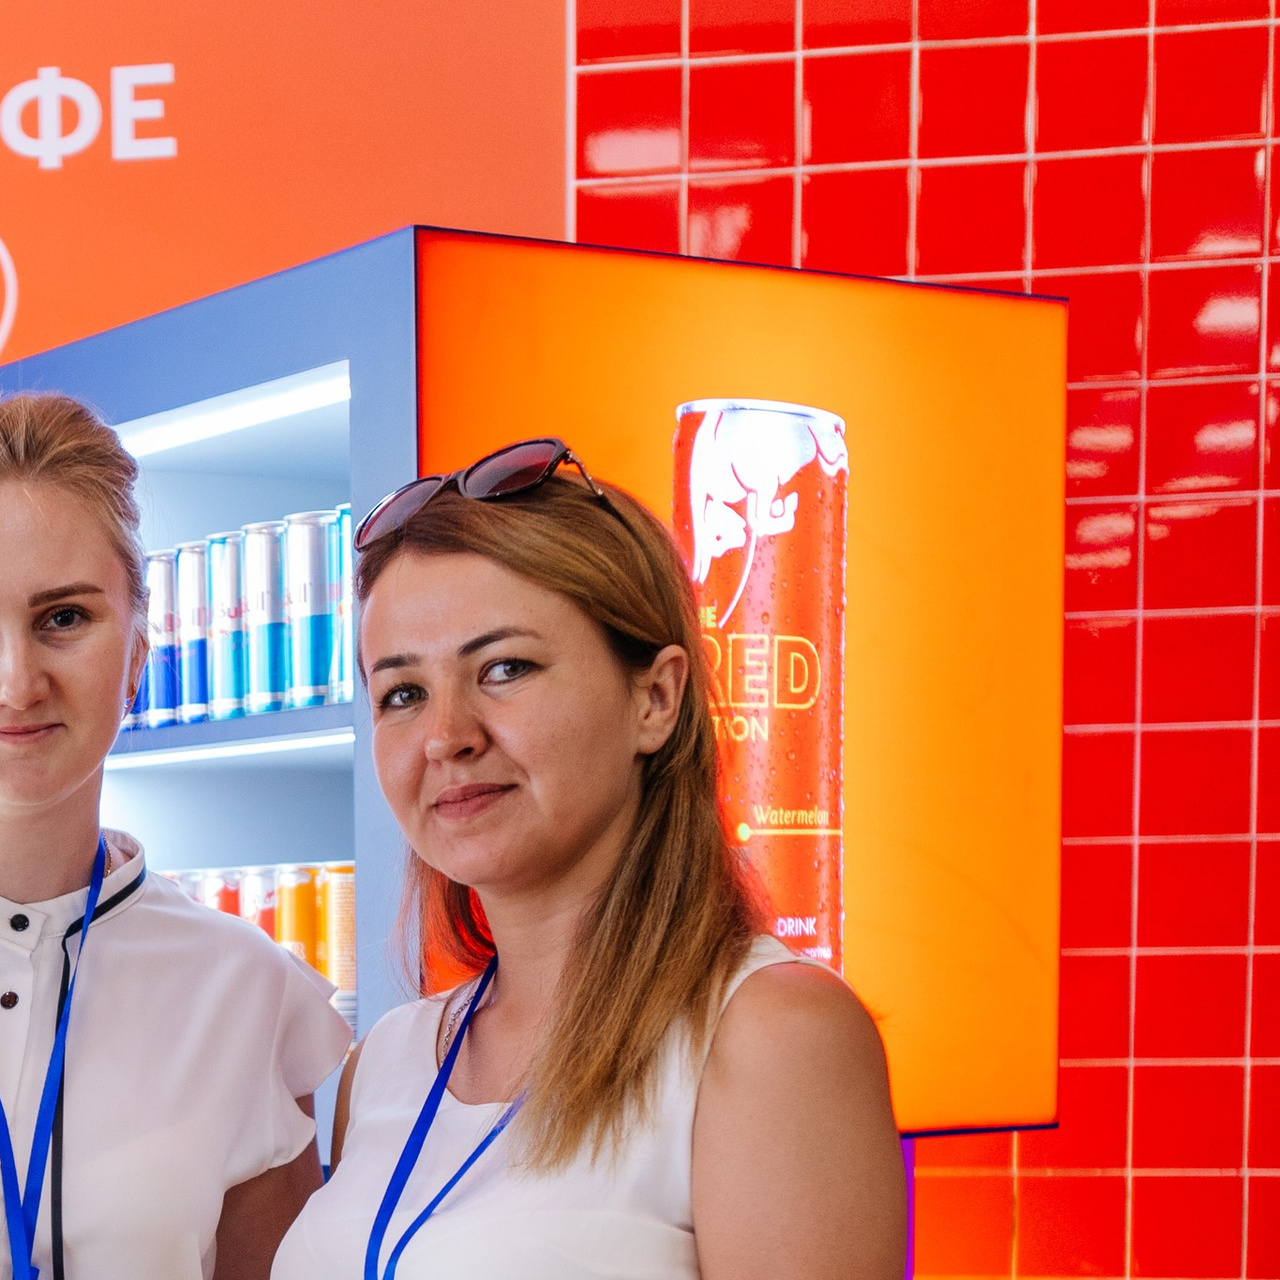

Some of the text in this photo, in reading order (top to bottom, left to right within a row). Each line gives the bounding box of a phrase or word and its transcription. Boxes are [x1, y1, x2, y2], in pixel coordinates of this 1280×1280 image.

[701, 634, 821, 709] RED
[711, 715, 769, 742] TION
[753, 805, 829, 825] Watermelon
[777, 916, 817, 937] DRINK
